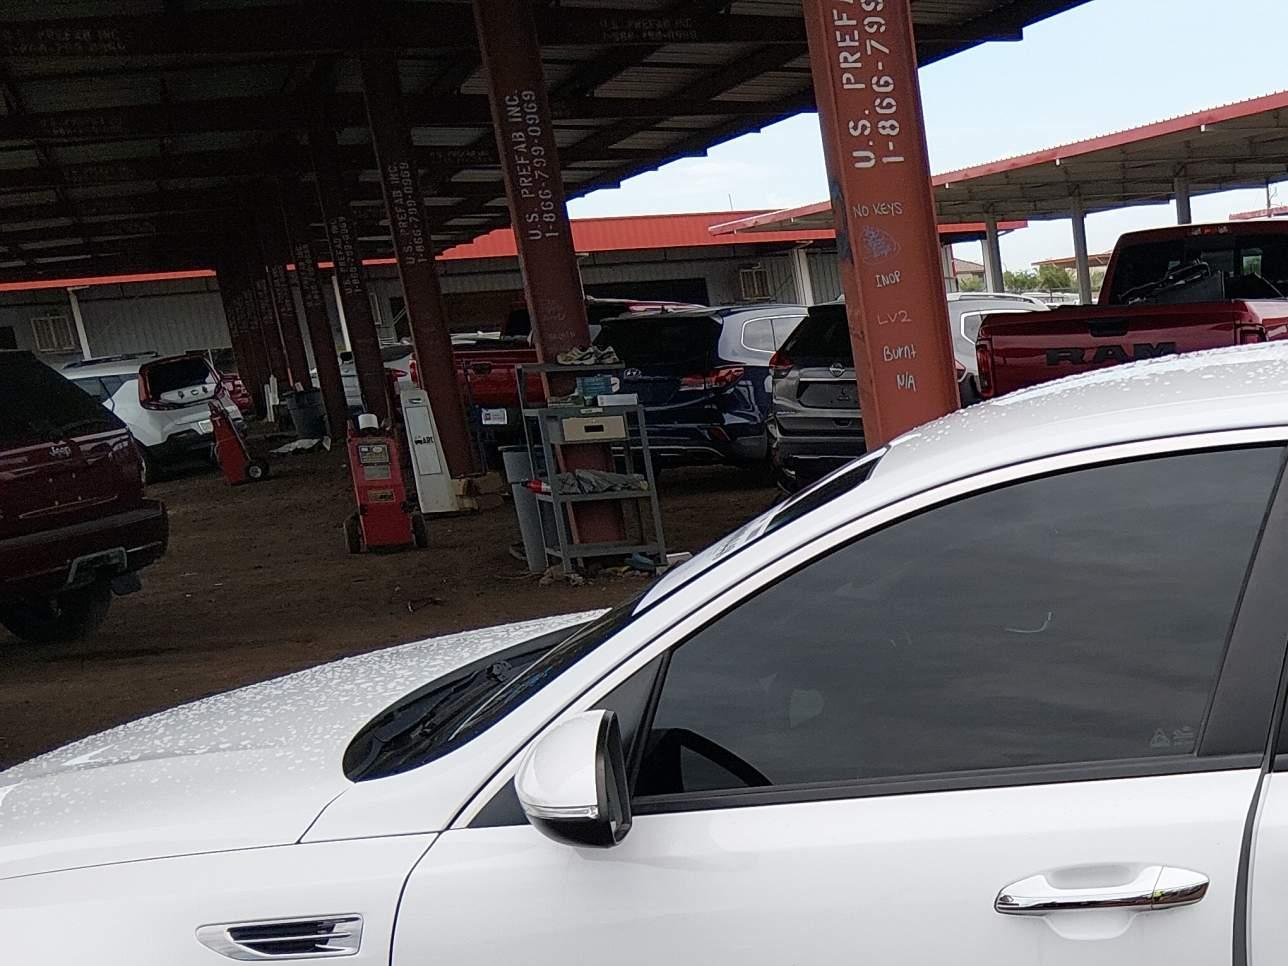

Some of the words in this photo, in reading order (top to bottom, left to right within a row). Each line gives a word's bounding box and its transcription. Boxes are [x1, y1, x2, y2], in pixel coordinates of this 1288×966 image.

[832, 0, 866, 89] PREF
[505, 88, 523, 123] INC.
[848, 109, 876, 168] U.S.
[512, 131, 535, 200] PREFAB
[521, 90, 560, 239] 1-866-799-0969
[853, 203, 869, 218] NO
[872, 202, 903, 216] KEYS
[525, 207, 543, 241] U.S.
[875, 270, 901, 288] INOP
[877, 310, 912, 325] LV2
[883, 344, 917, 361] Burnt
[1045, 341, 1176, 366] RAM
[896, 371, 917, 392] N/A
[49, 446, 72, 458] Jeep
